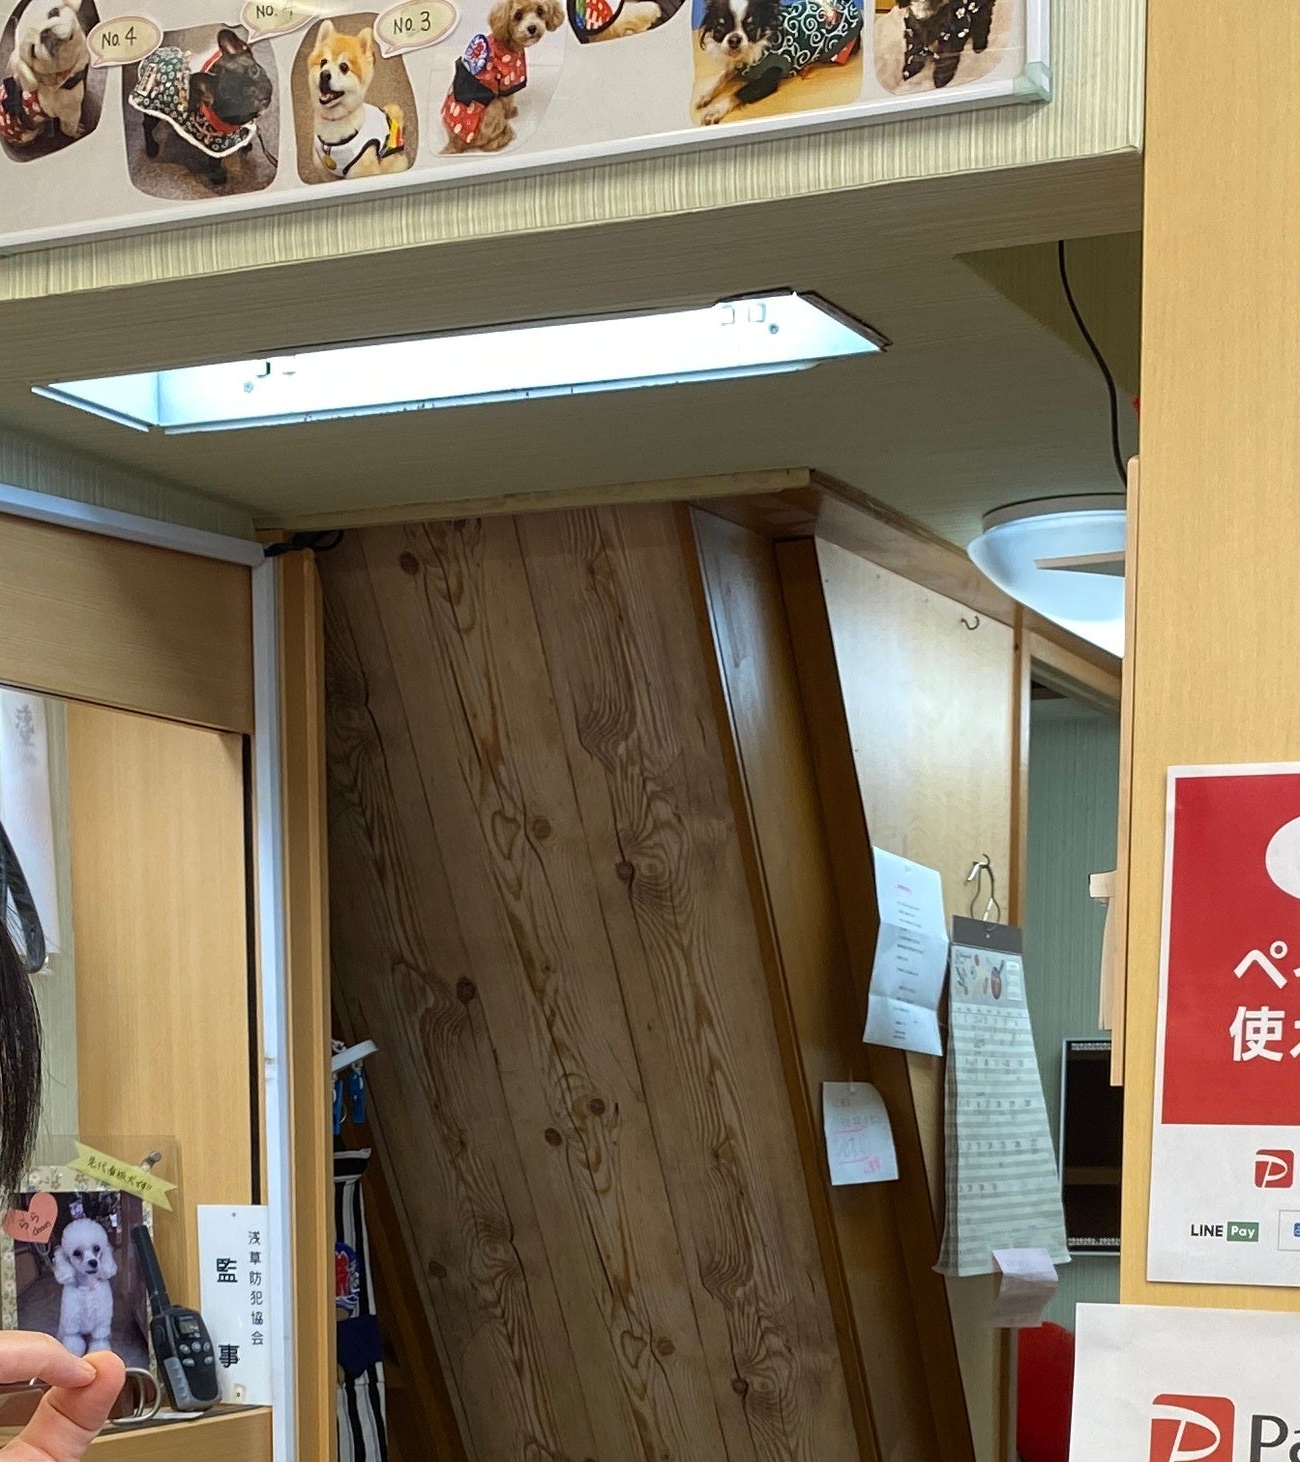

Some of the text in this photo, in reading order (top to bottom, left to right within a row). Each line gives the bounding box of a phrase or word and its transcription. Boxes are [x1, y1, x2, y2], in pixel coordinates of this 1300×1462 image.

[419, 11, 433, 32] 3
[125, 26, 137, 45] 4
[1190, 1224, 1256, 1240] LINE Pay
[248, 1231, 264, 1345] 浅草防犯協会
